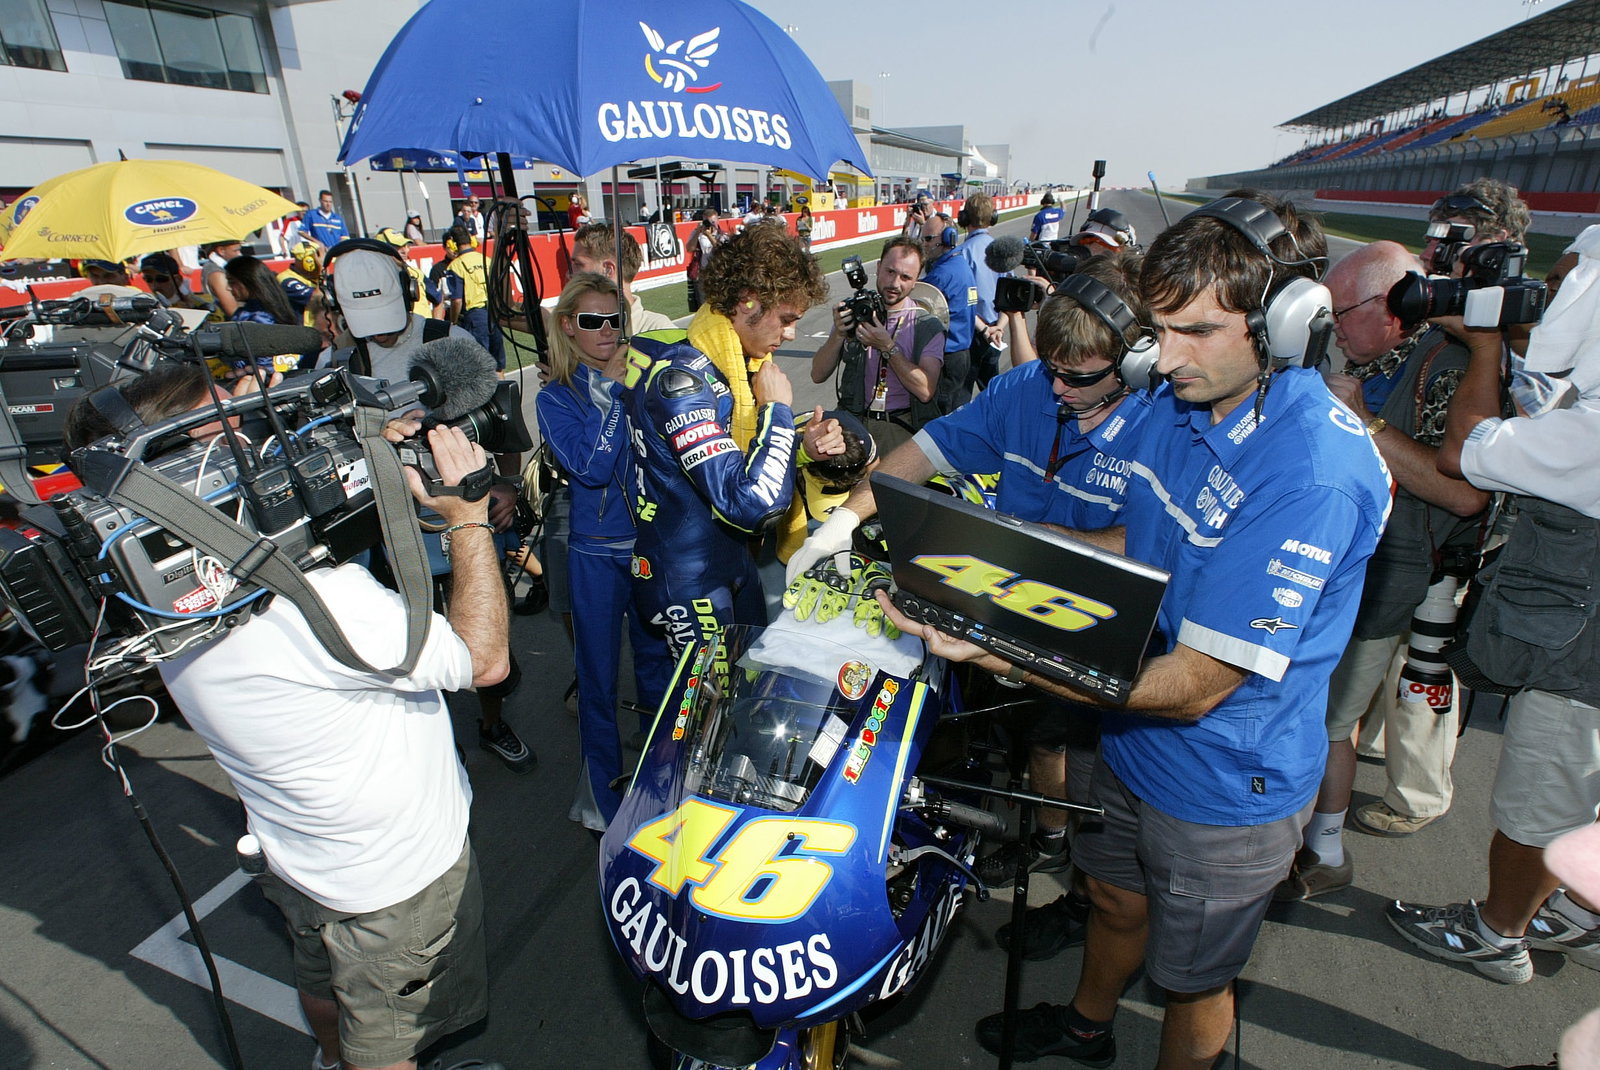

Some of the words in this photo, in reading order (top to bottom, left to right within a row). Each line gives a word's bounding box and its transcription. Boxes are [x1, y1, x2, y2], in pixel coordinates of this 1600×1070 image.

[598, 101, 792, 150] GAULOISES
[135, 200, 184, 215] CAMEL
[47, 231, 100, 243] CORREOS
[665, 408, 716, 434] GAULOISES
[675, 423, 720, 449] MOTUL
[682, 442, 736, 467] KERAKOLL
[751, 425, 795, 507] YAMAHA
[1280, 539, 1332, 565] MOTUL
[909, 554, 1118, 632] 46
[843, 745, 870, 784] THE
[861, 678, 899, 746] DOCTOR
[624, 794, 858, 924] 46
[611, 876, 838, 1004] GAULOISES
